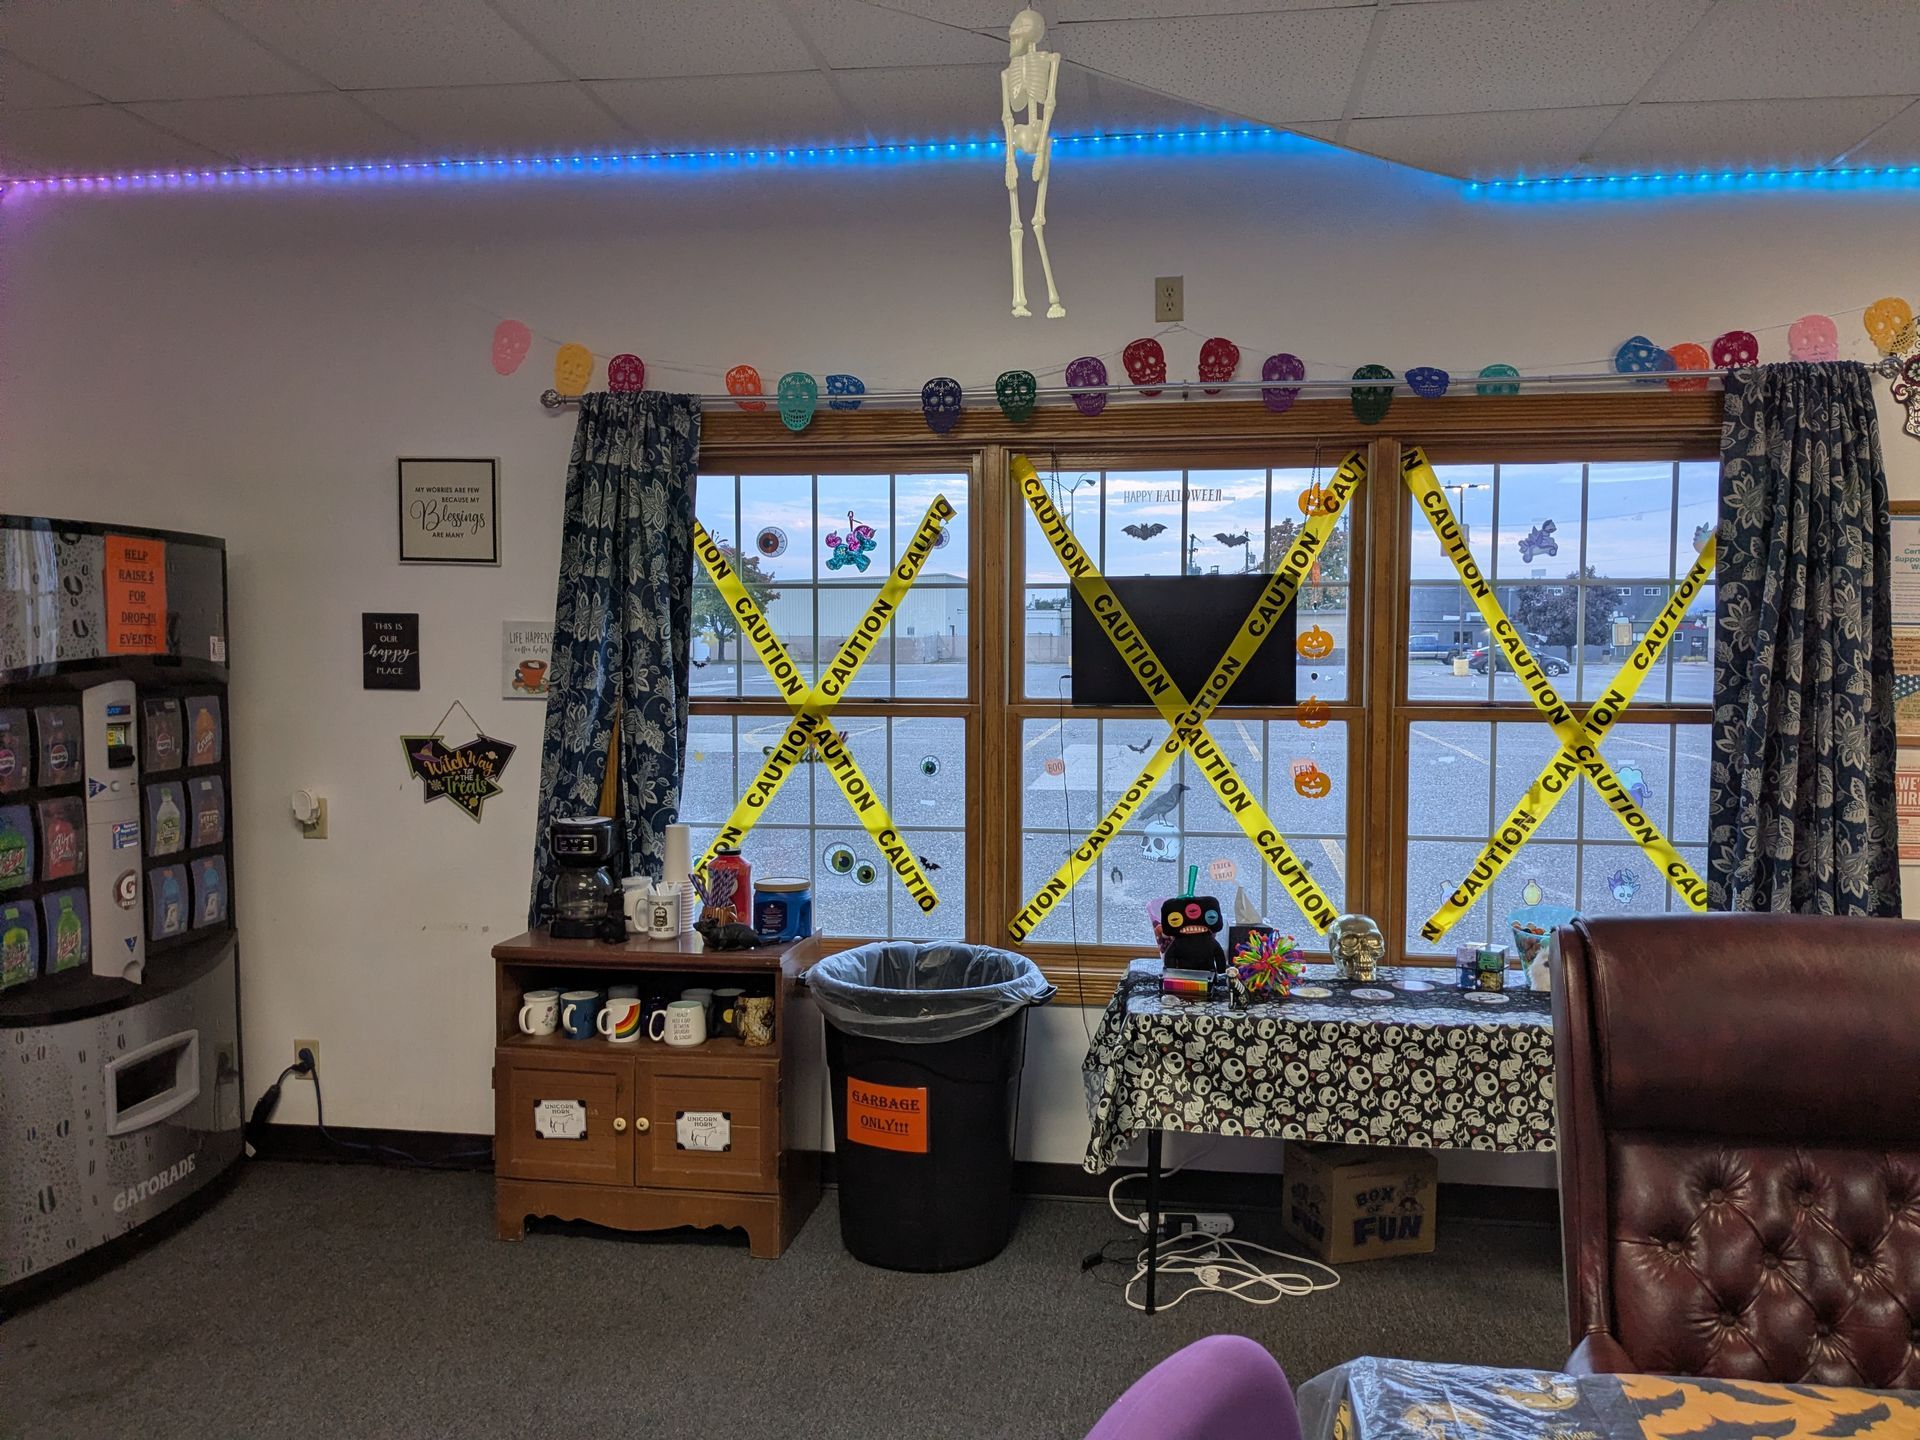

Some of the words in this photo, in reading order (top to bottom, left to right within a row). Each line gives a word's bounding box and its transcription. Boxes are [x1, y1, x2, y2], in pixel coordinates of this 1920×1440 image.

[410, 499, 485, 535] Blessings
[1123, 490, 1153, 503] HAPPY
[119, 569, 147, 580] RAISE
[125, 549, 148, 561] HELP
[129, 590, 146, 602] FOR
[1024, 478, 1090, 578] CAUTION
[1094, 594, 1170, 696] CAUTION
[1248, 531, 1320, 637] CAUTION
[1424, 490, 1489, 599] CAUTION
[1496, 619, 1570, 725] CAUTION
[509, 631, 523, 644] LIFE
[525, 631, 554, 644] HAPPENS
[1634, 563, 1706, 670] CAUTION
[364, 644, 417, 662] happy
[735, 597, 803, 697] CAUTION
[822, 598, 893, 697] CAUTION
[376, 667, 405, 675] PLACE
[1165, 656, 1241, 753] CAUTION
[424, 750, 469, 775] Witch
[467, 750, 494, 777] Way
[746, 712, 818, 808] CAUTION
[442, 774, 487, 794] Treats
[1575, 745, 1660, 844] CAUTION
[1076, 773, 1155, 862] CAUTION
[1256, 829, 1336, 932] CAUTION
[1450, 809, 1537, 907] CAUTION
[852, 1089, 920, 1110] GARBAGE
[861, 1115, 909, 1133] ONLY!!!
[113, 1153, 196, 1212] GATORADE
[1353, 1215, 1423, 1246] FUN
